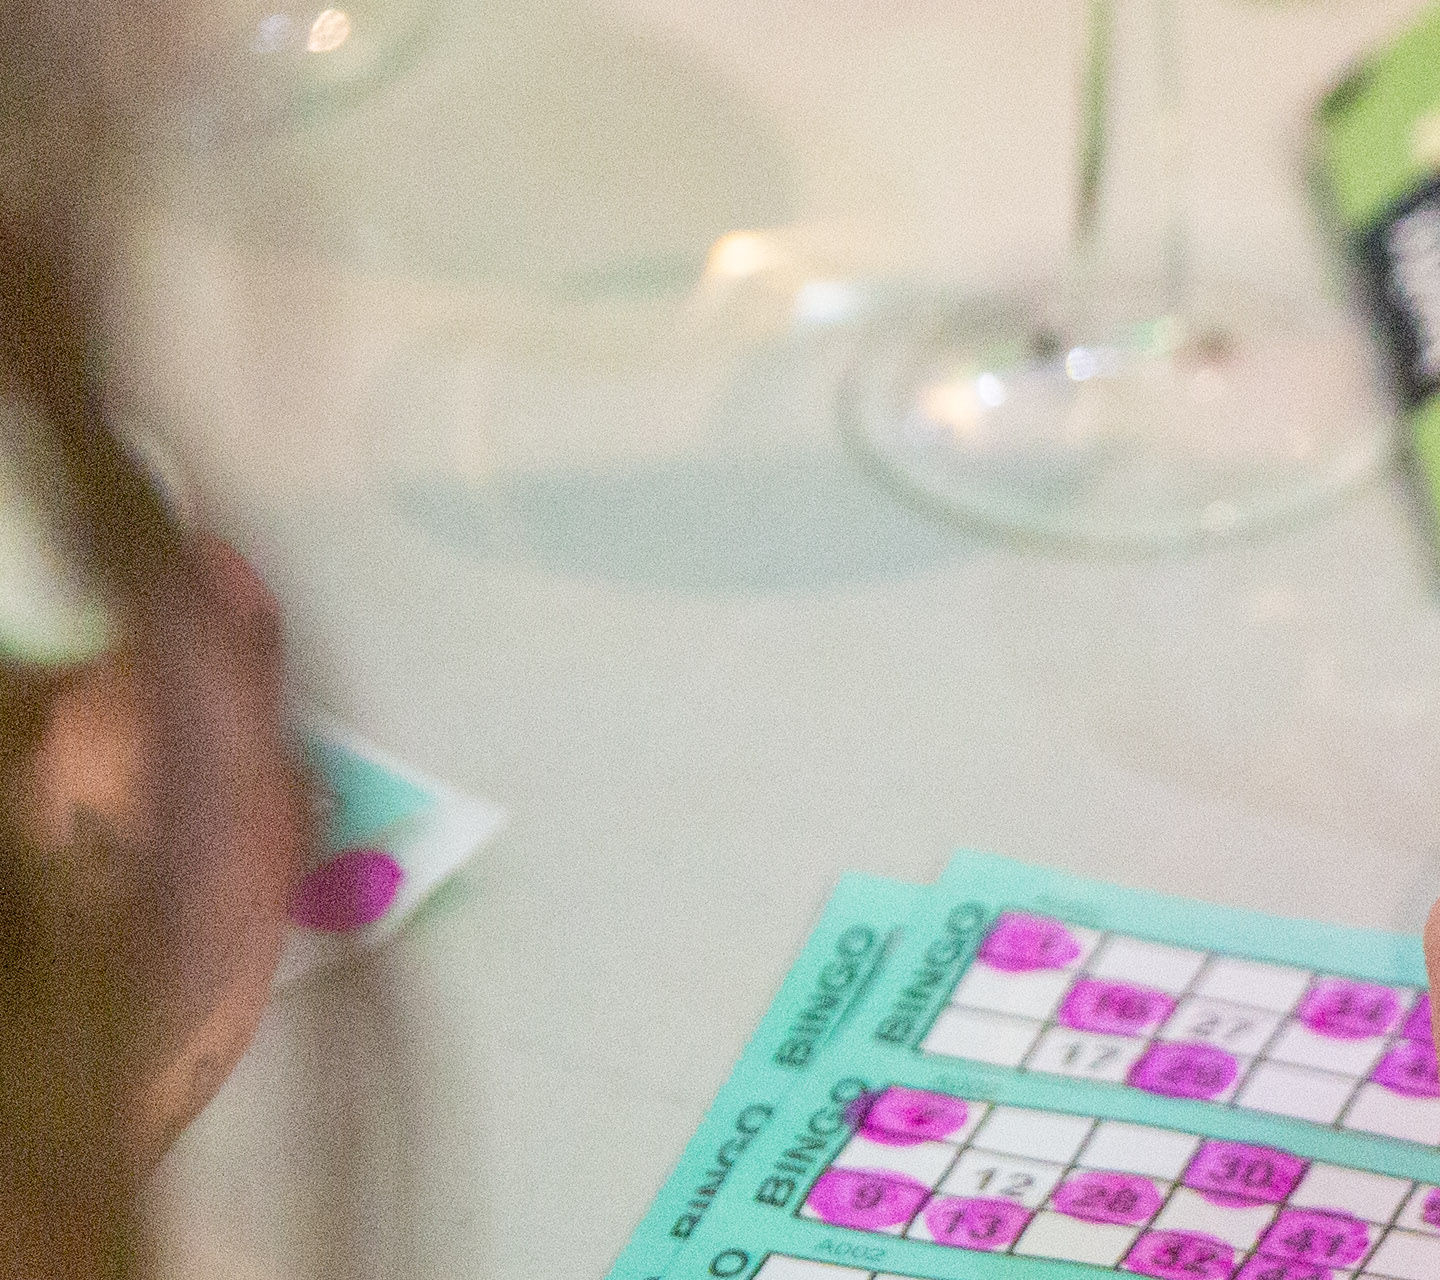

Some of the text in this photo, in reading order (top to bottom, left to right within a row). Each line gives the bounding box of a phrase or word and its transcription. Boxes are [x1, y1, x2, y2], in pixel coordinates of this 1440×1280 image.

[1191, 1014, 1252, 1039] 27
[1062, 1042, 1121, 1071] 17
[1206, 1153, 1273, 1187] 30
[851, 1181, 888, 1211] 9
[945, 1209, 1004, 1241] 13
[977, 1167, 1036, 1199] 12
[1283, 1227, 1345, 1258] 41
